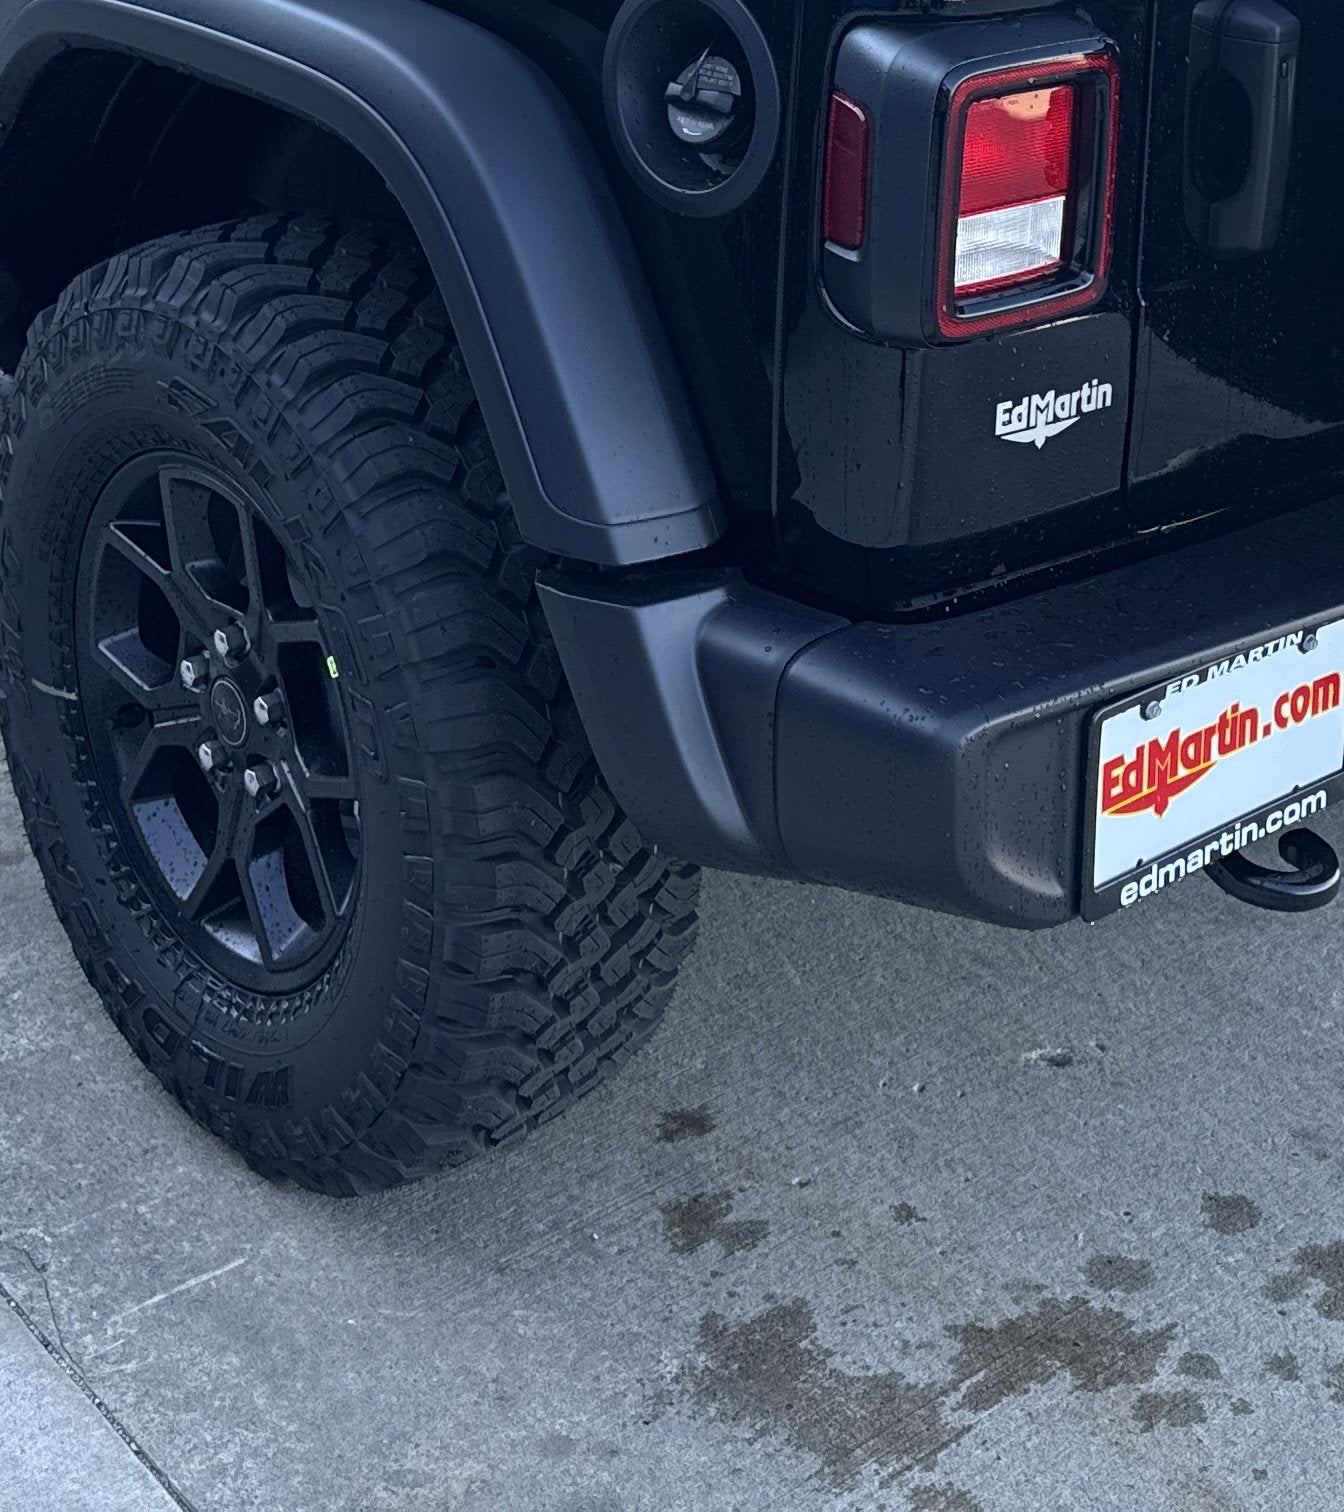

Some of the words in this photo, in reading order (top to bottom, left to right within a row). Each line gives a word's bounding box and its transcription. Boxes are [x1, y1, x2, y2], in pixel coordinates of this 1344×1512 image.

[995, 378, 1113, 436] EdMartin
[1165, 673, 1200, 697] ED
[1206, 630, 1304, 682] MARTIN
[1101, 671, 1342, 814] EdMartin.com
[1120, 789, 1328, 906] edmartin.com
